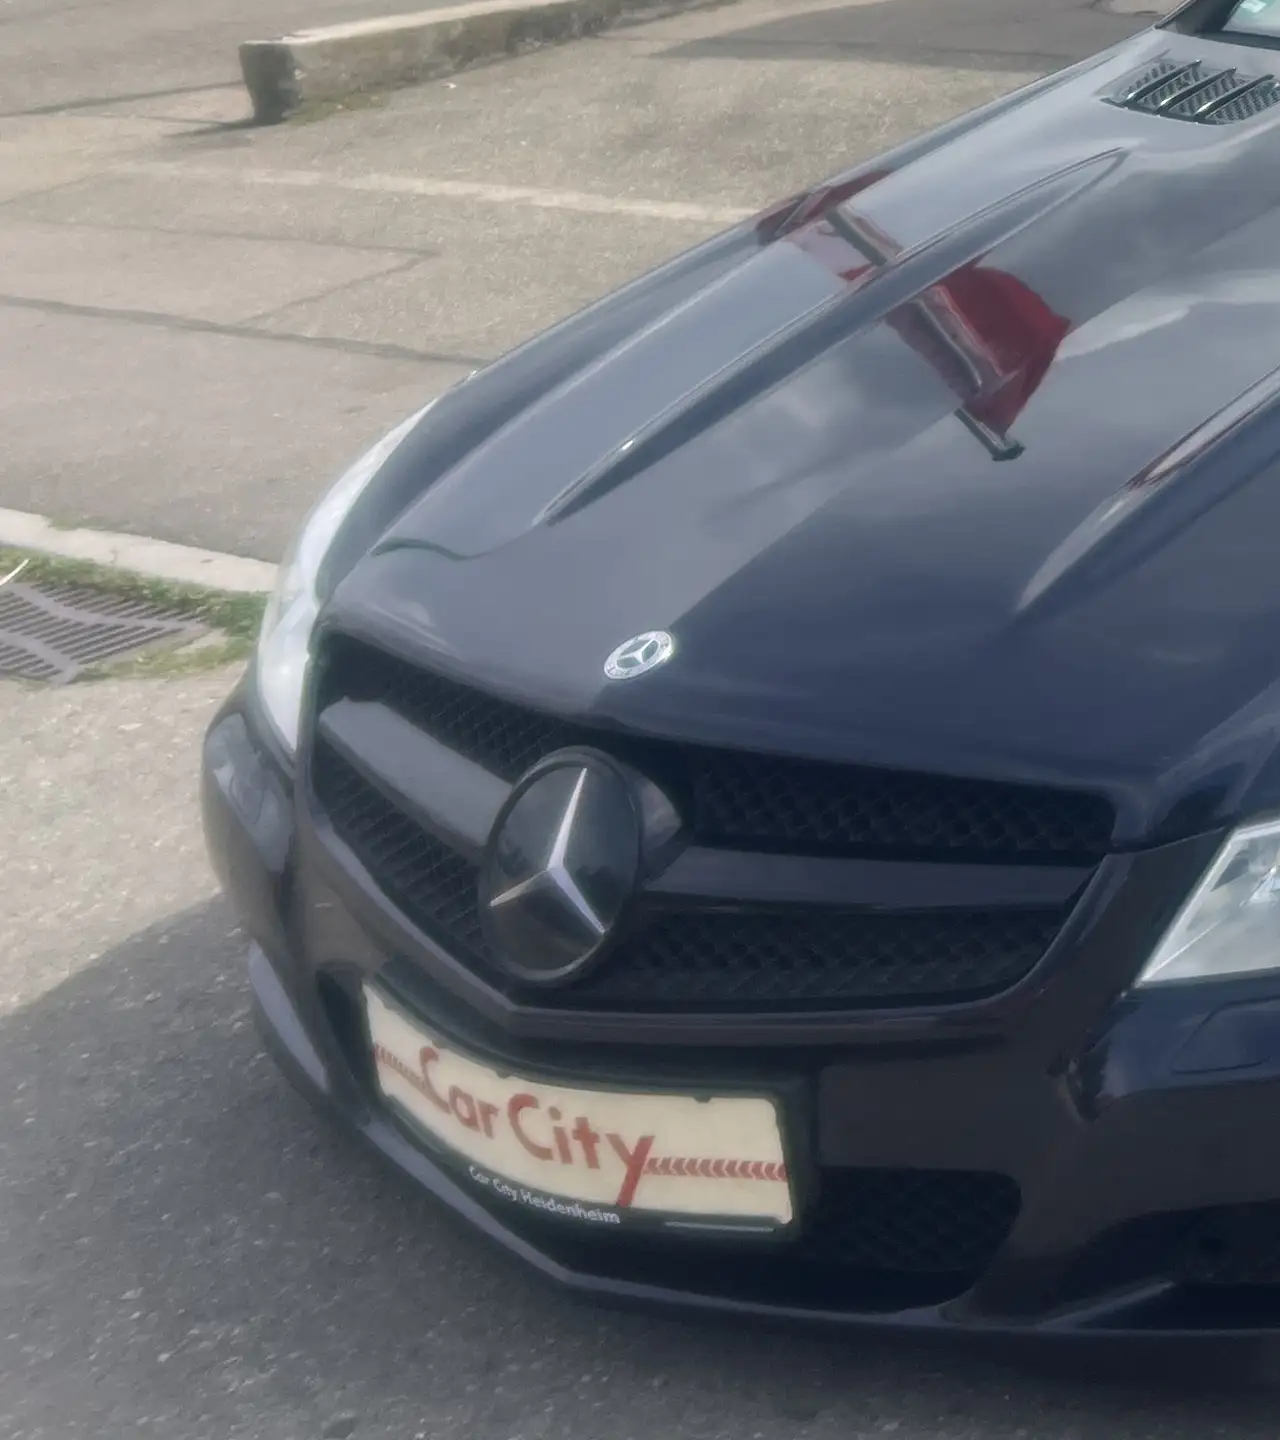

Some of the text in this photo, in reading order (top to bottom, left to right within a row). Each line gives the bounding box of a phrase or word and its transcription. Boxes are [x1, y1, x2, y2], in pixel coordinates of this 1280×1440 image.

[419, 1045, 655, 1208] Car City
[521, 1189, 620, 1224] Heidenheim
